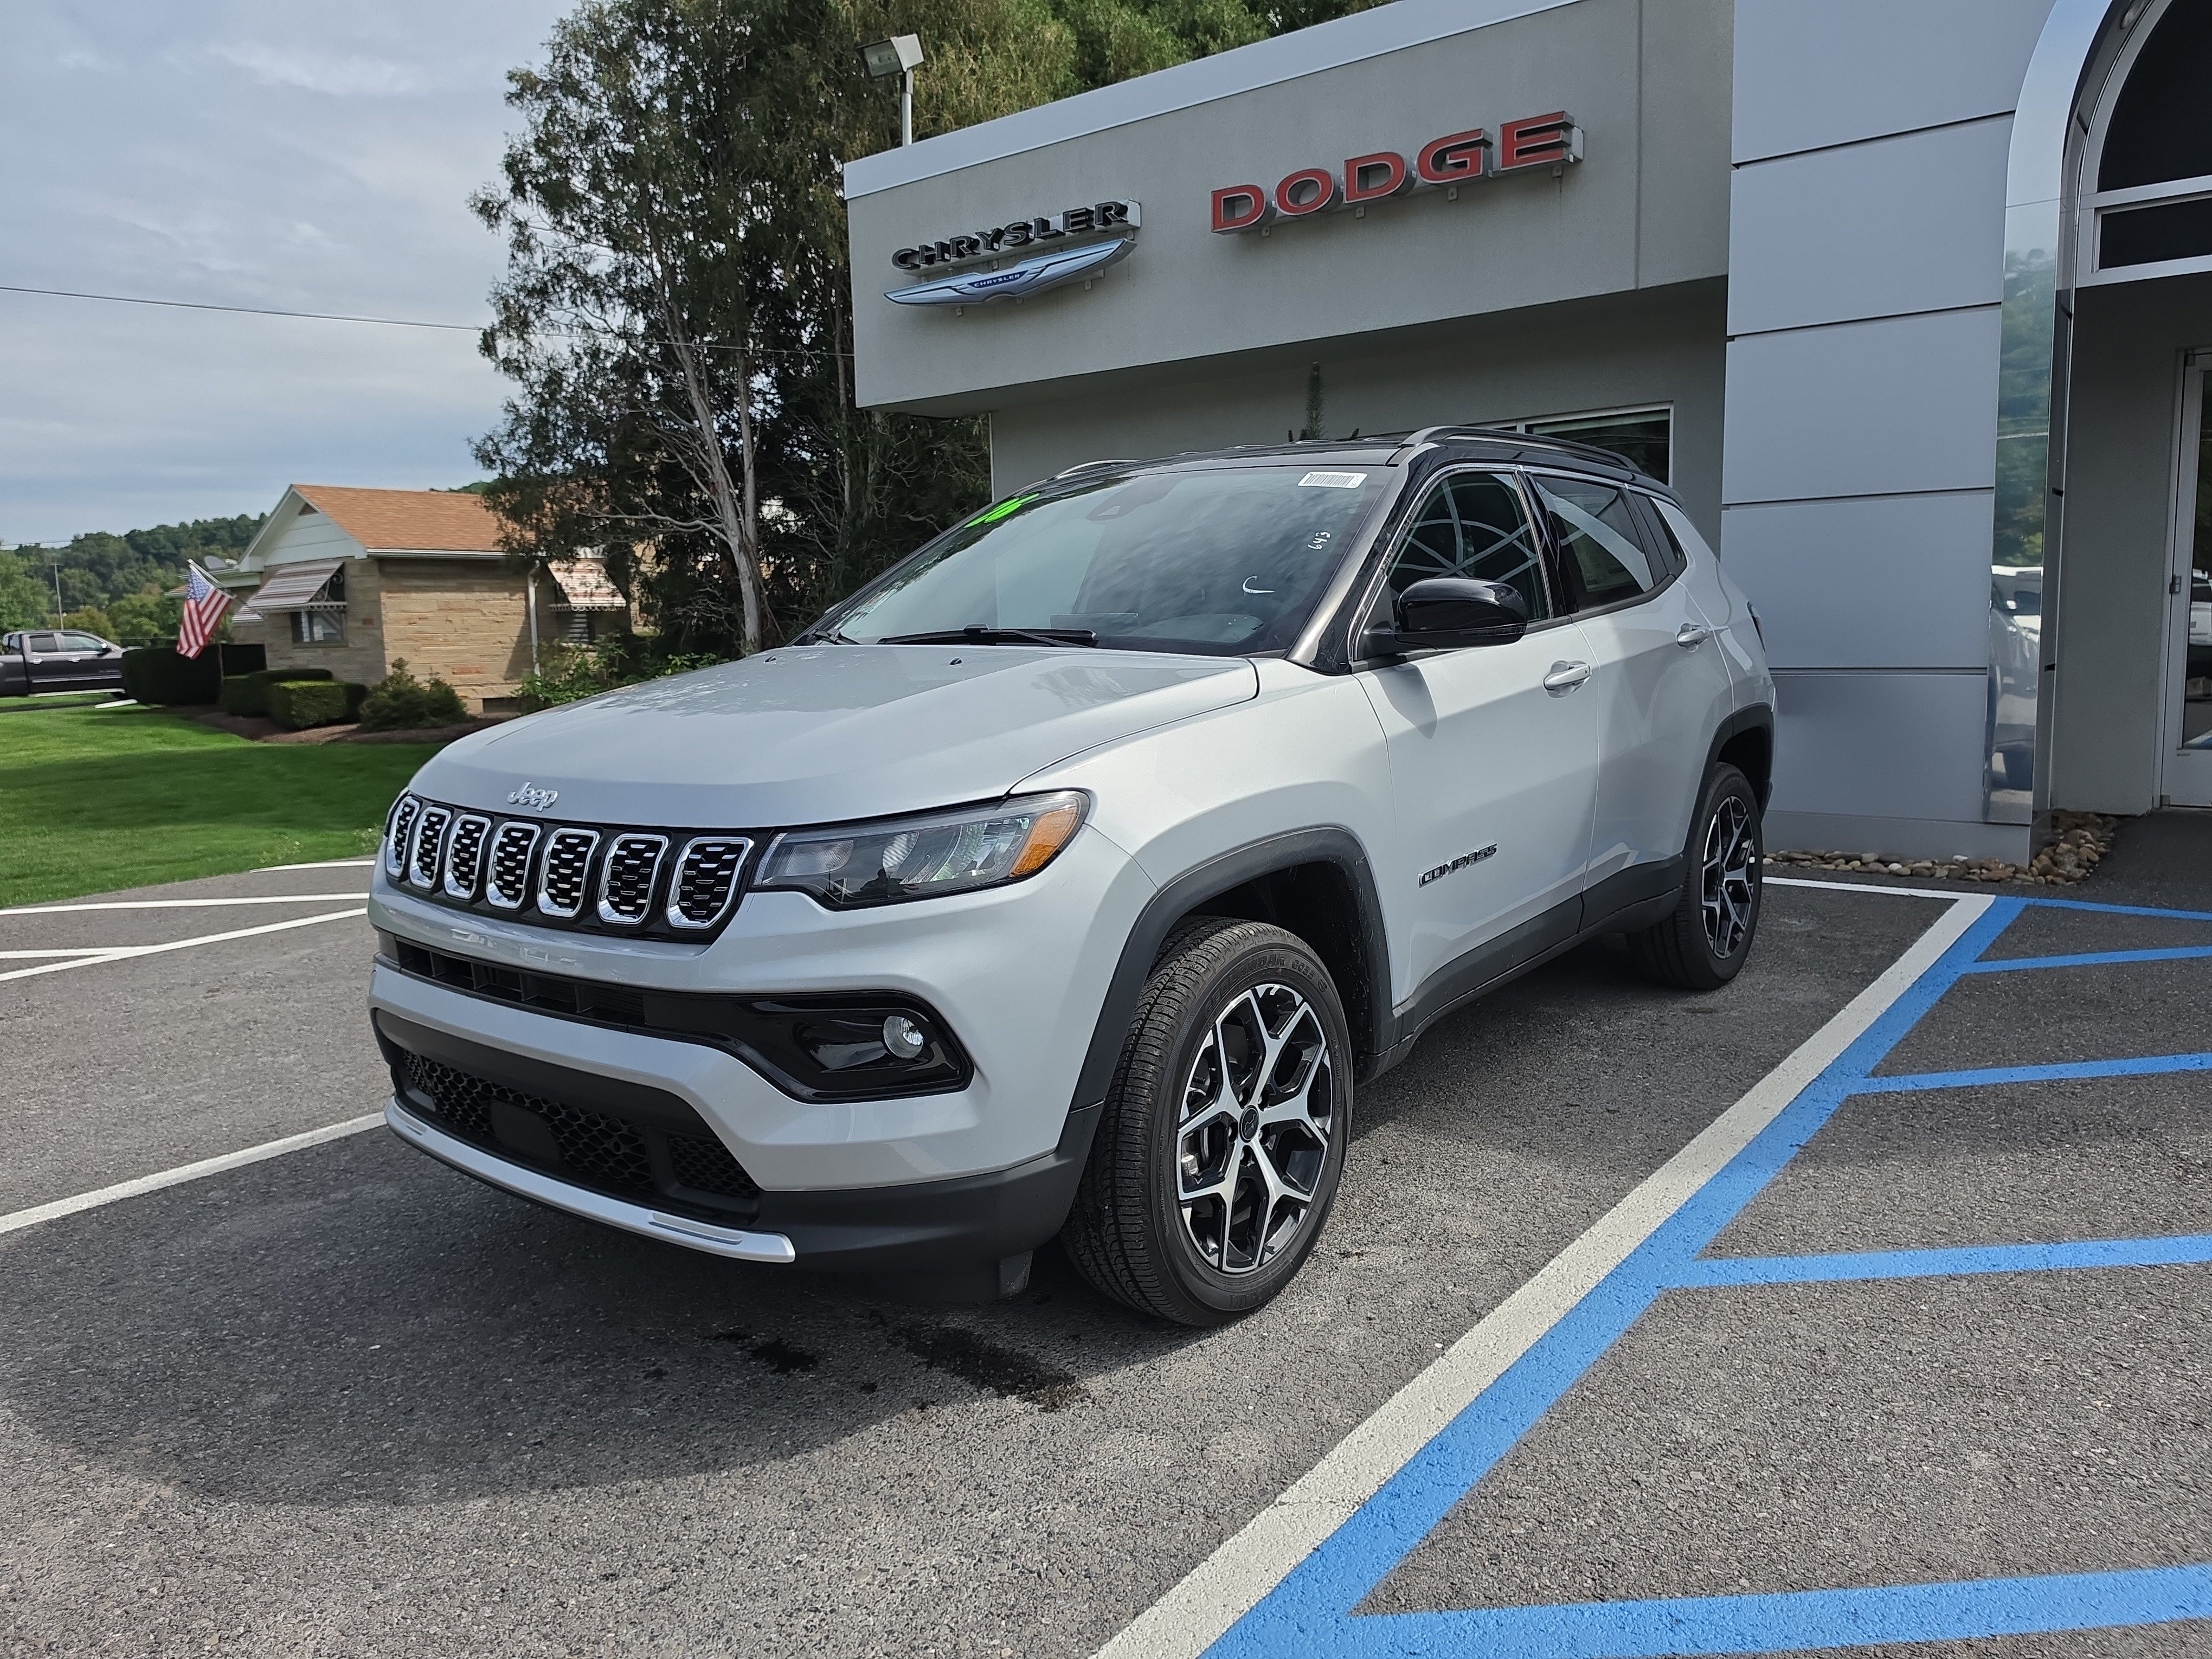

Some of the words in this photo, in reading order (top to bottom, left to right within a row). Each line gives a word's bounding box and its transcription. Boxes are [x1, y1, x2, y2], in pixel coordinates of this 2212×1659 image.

[1211, 111, 1570, 233] DODGE
[892, 200, 1129, 270] CHRYSLER
[974, 274, 1020, 287] CHRYSLER
[507, 781, 558, 812] Jeep
[1417, 843, 1497, 889] COMPASS
